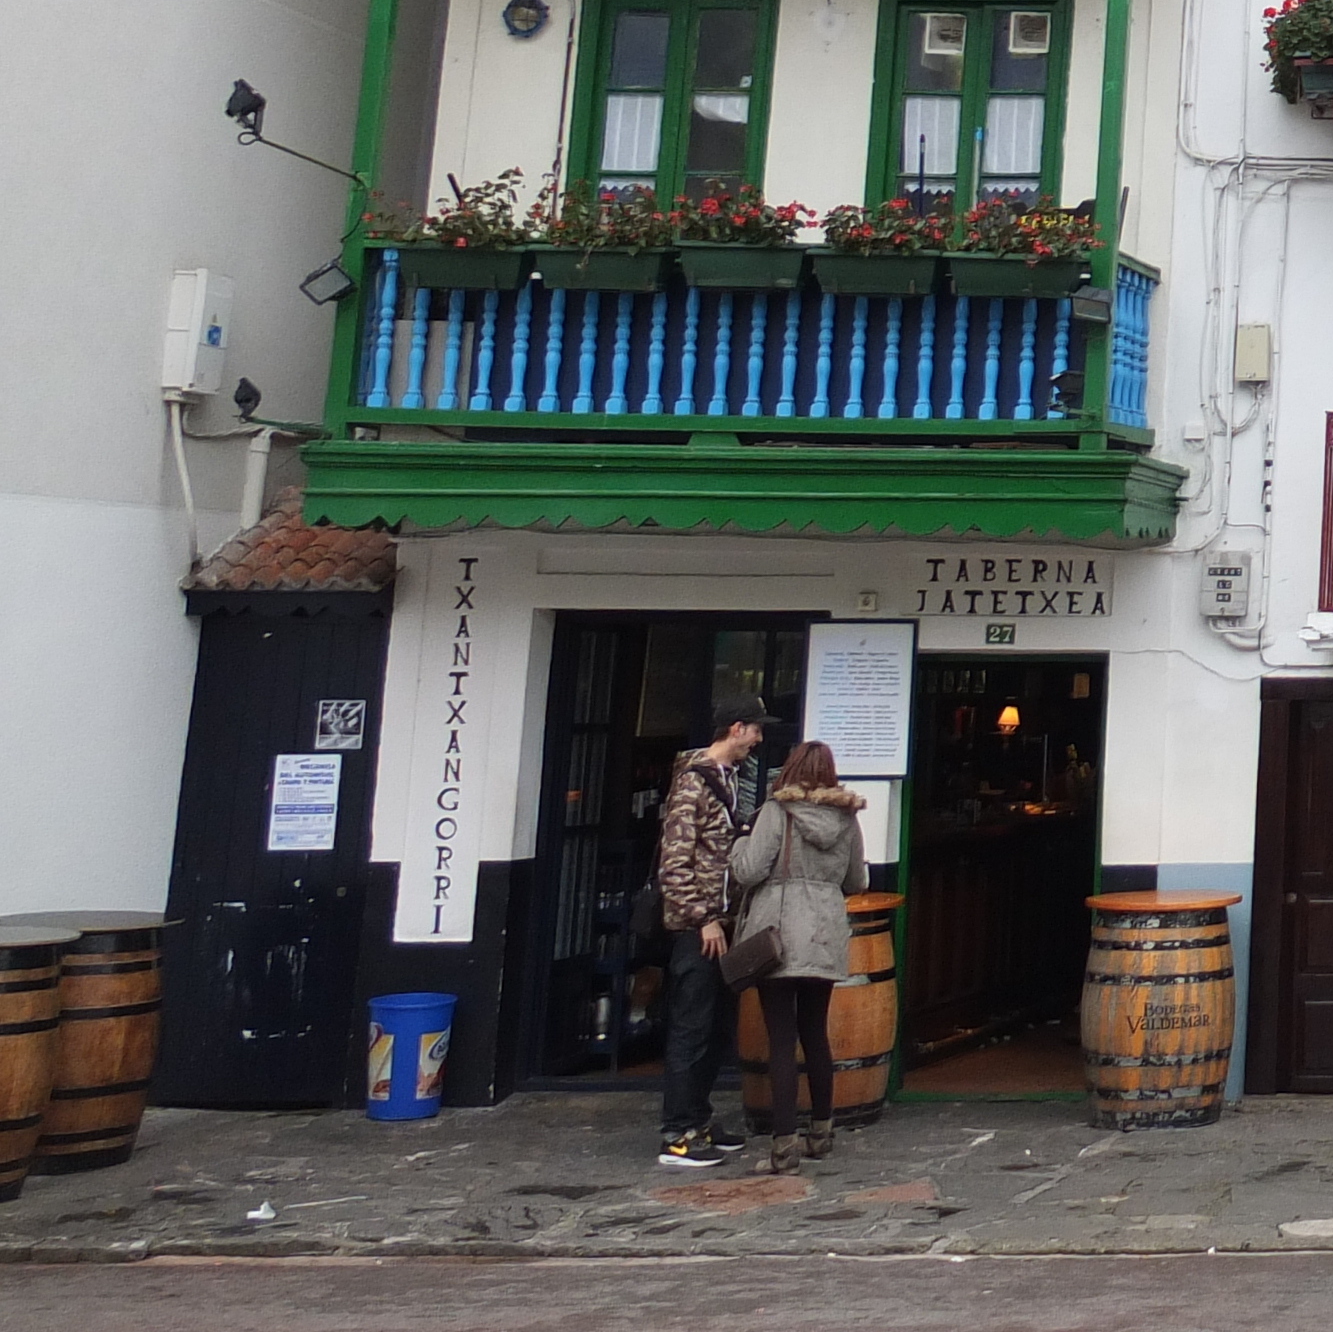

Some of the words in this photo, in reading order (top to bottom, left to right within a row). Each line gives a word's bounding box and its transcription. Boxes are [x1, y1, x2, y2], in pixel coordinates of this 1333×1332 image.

[925, 558, 1098, 584] TABERNA
[916, 589, 1106, 615] JATETXEA
[988, 626, 1014, 643] 27
[430, 557, 480, 935] TXANTXANGORRI
